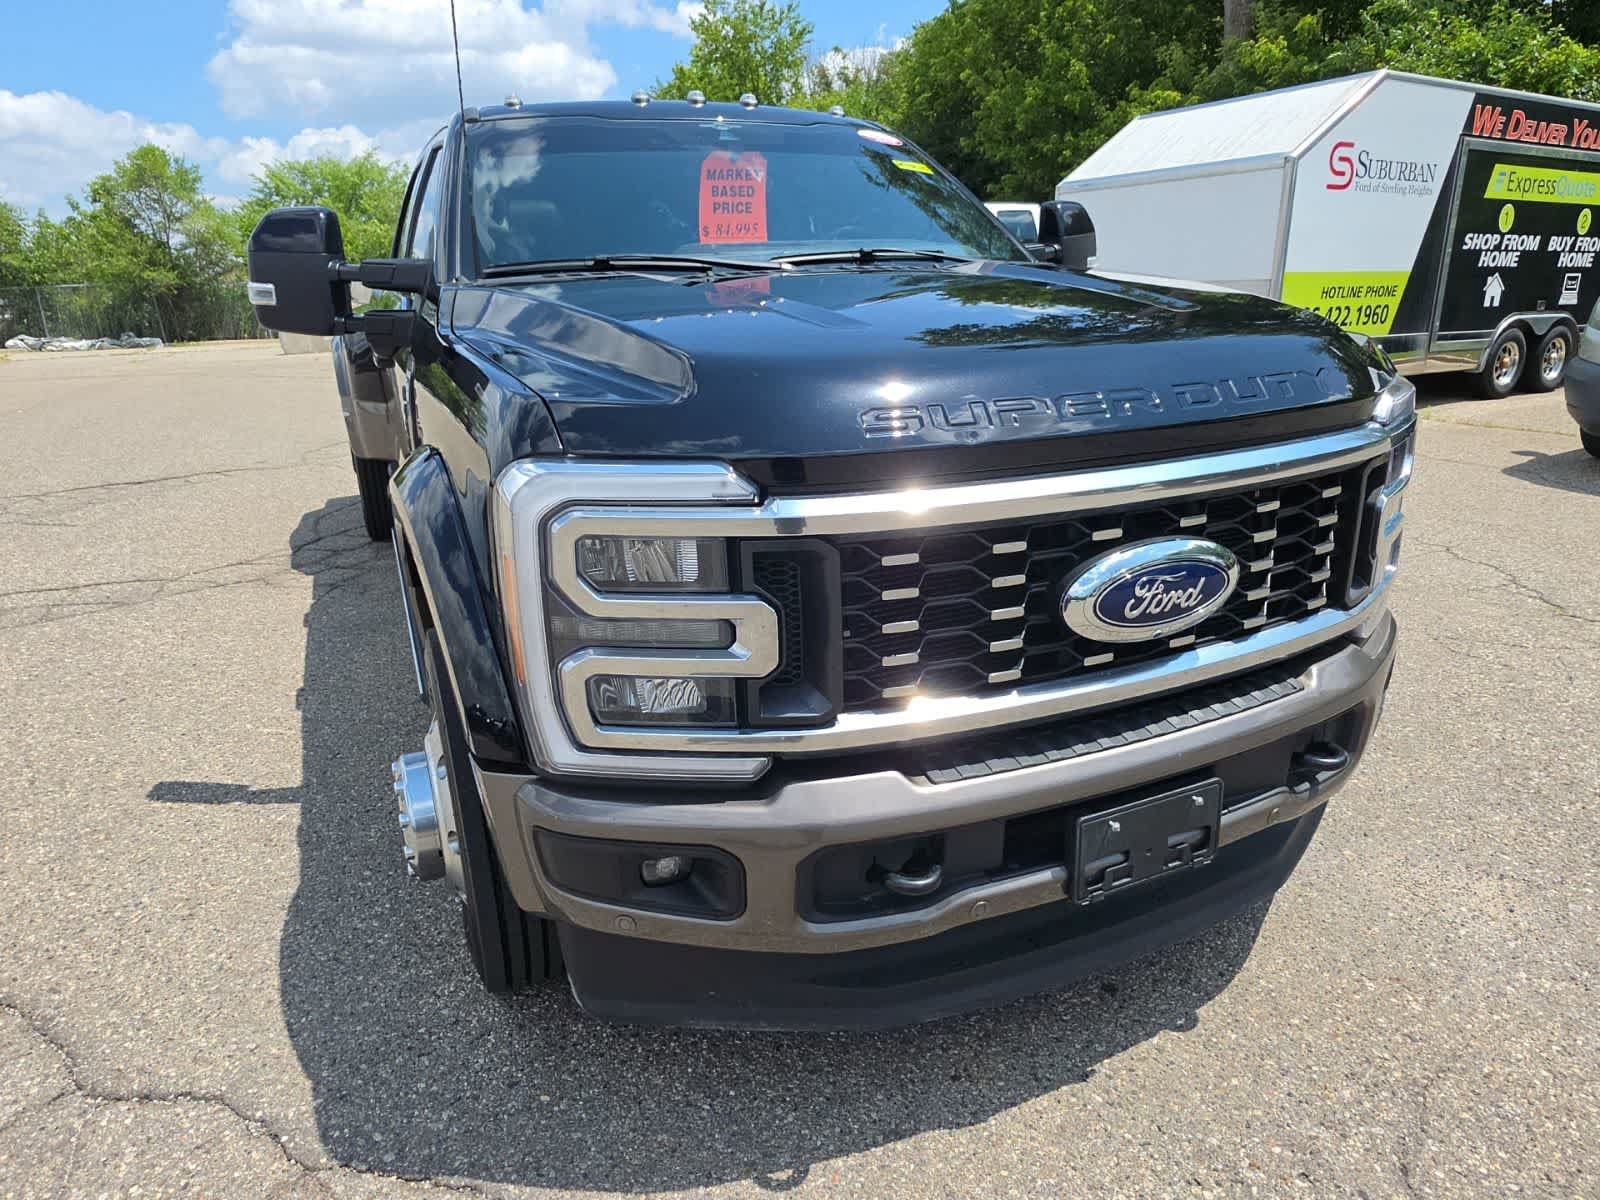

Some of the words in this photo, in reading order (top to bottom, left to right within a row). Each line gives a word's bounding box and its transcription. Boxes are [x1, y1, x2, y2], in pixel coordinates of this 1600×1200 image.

[711, 185, 755, 198] BASED
[1354, 181, 1371, 193] Ford
[1372, 181, 1381, 193] of
[1381, 182, 1408, 197] Sterling
[1408, 184, 1433, 198] Heights
[713, 202, 753, 214] PRICE
[1462, 233, 1501, 250] SHOP
[1501, 234, 1541, 251] FROM
[1547, 236, 1575, 252] BUY
[1478, 251, 1520, 267] HOME
[1557, 252, 1595, 268] HOME
[1321, 286, 1363, 299] HOTLINE
[1364, 285, 1398, 298] PHONE
[856, 387, 1165, 438] SUPER
[1171, 367, 1326, 410] DUTY
[1124, 571, 1205, 619] Ford
